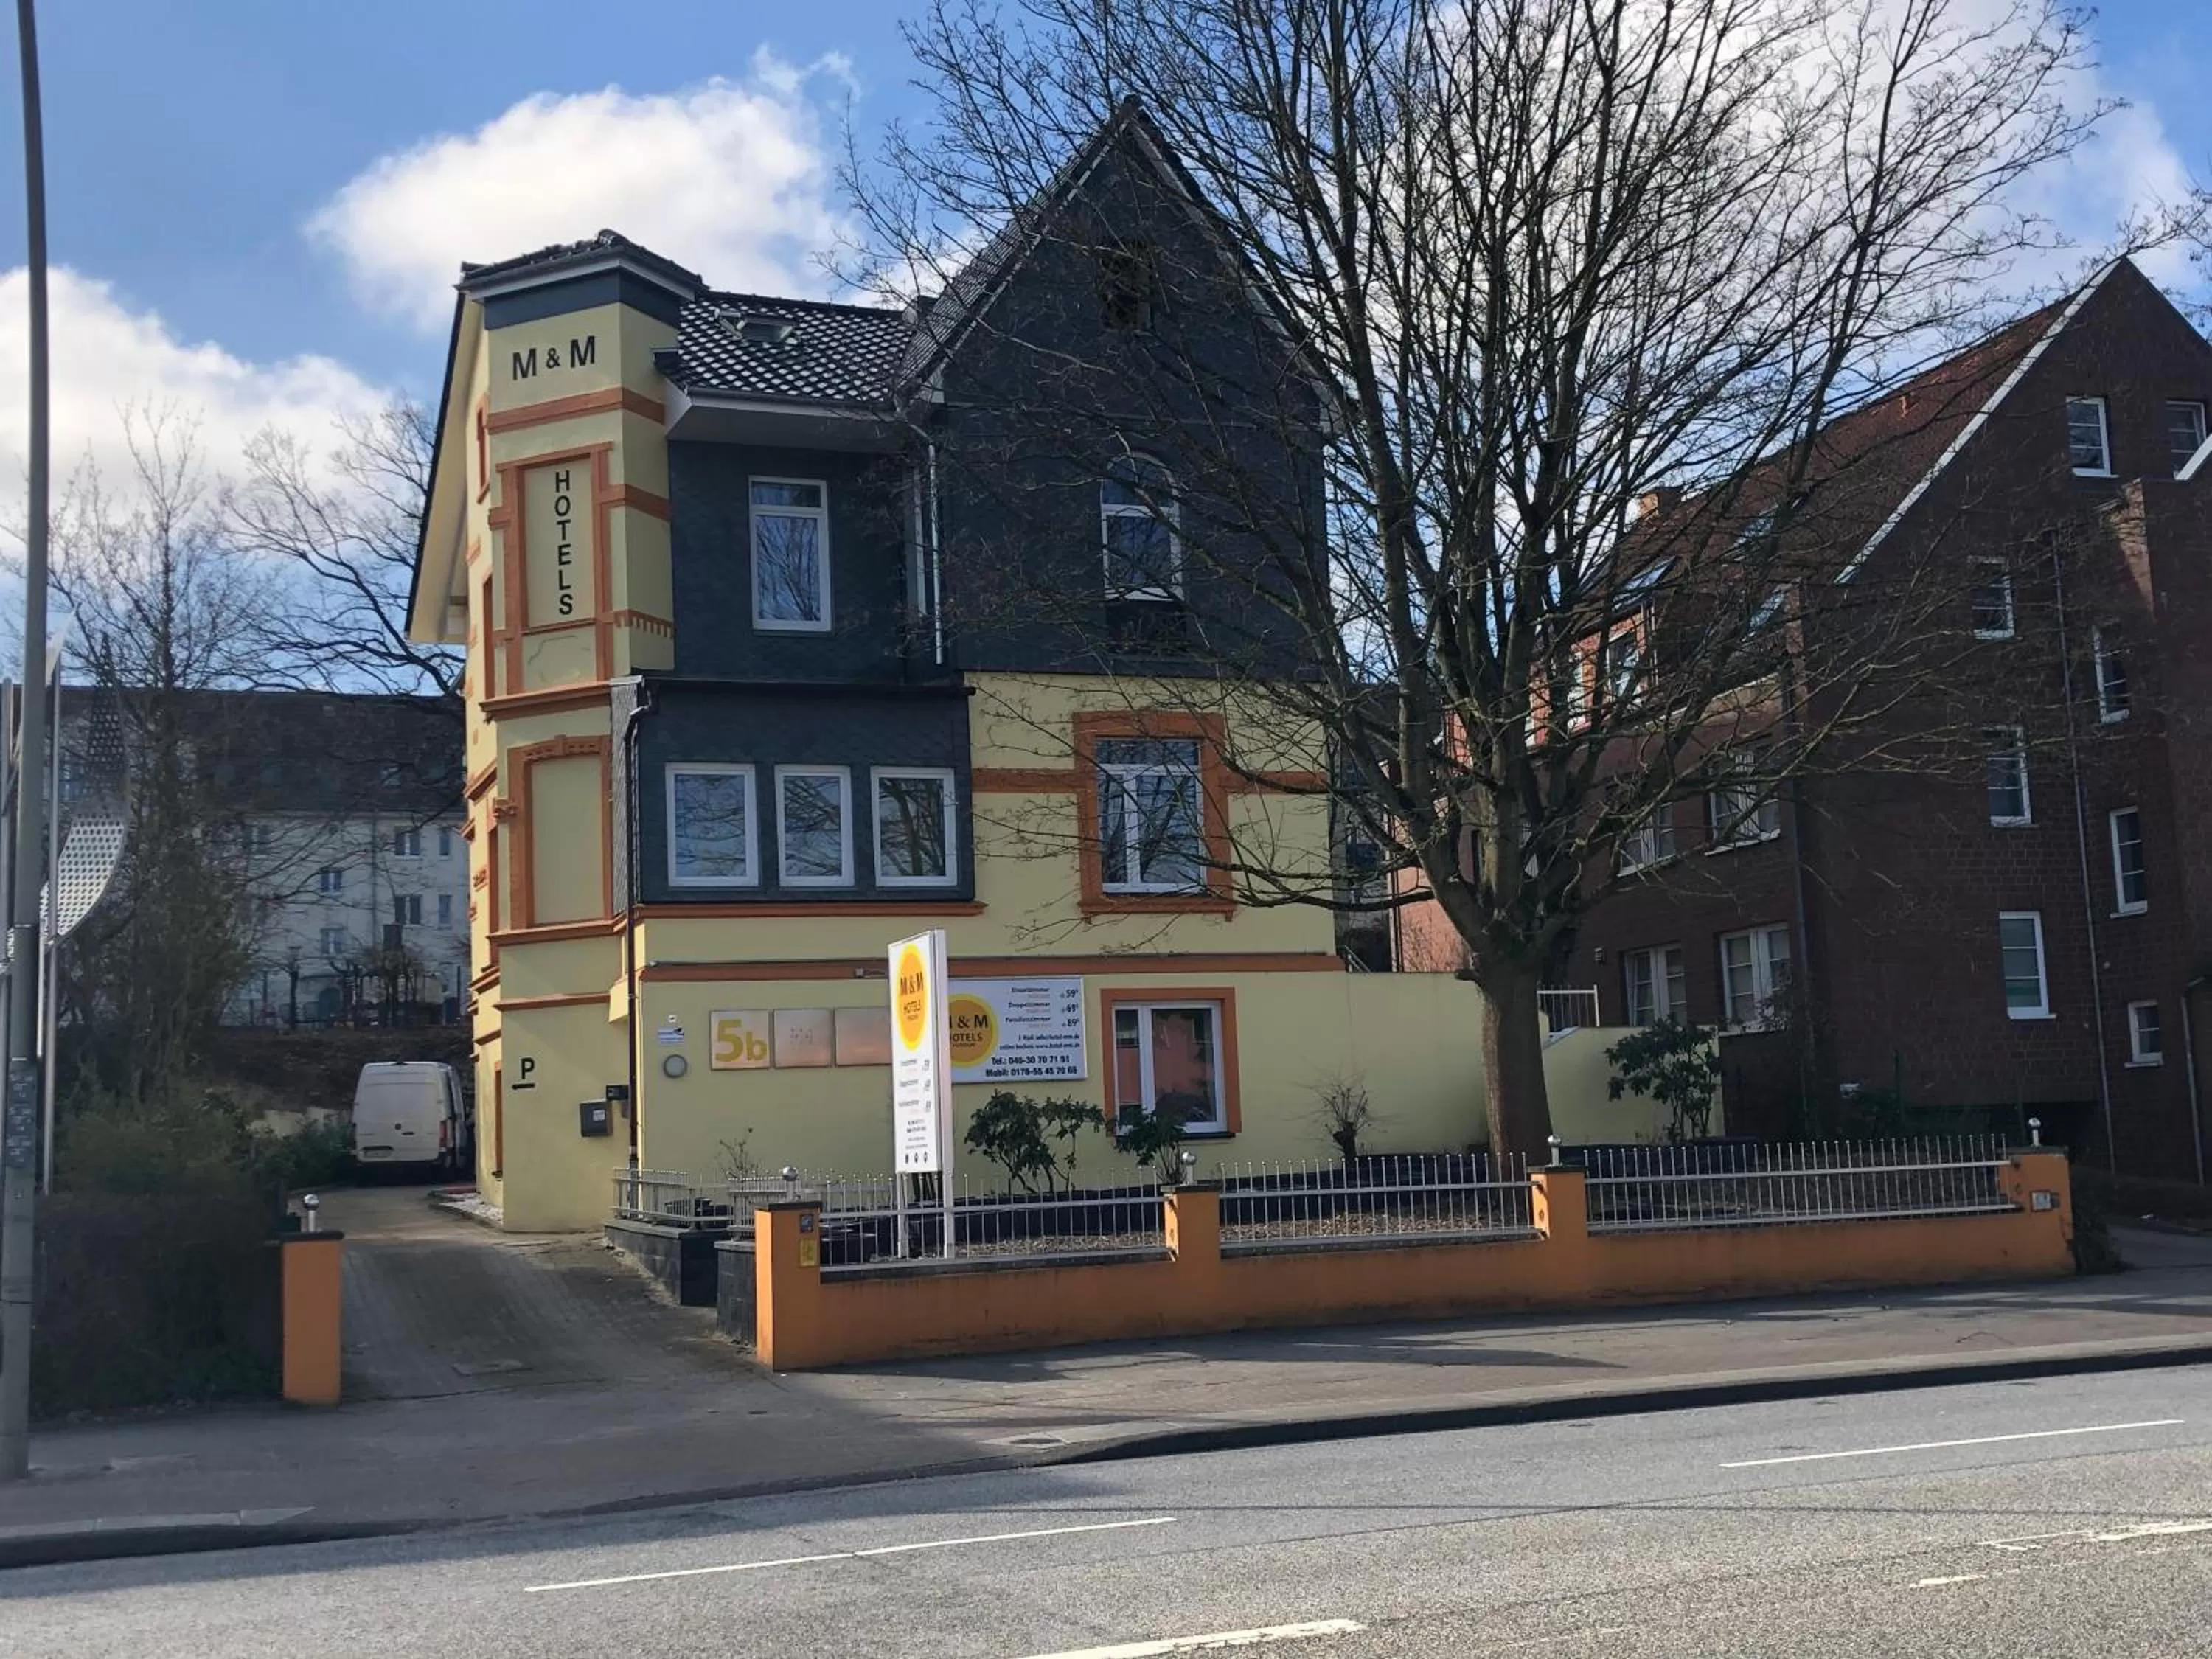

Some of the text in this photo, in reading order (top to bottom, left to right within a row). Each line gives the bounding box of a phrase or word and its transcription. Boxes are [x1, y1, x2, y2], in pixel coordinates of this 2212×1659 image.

[512, 335, 597, 381] M & M
[555, 470, 574, 616] HOTELS
[715, 1019, 768, 1062] 5b
[957, 1015, 970, 1029] &
[974, 1014, 989, 1029] M
[521, 1057, 535, 1080] P
